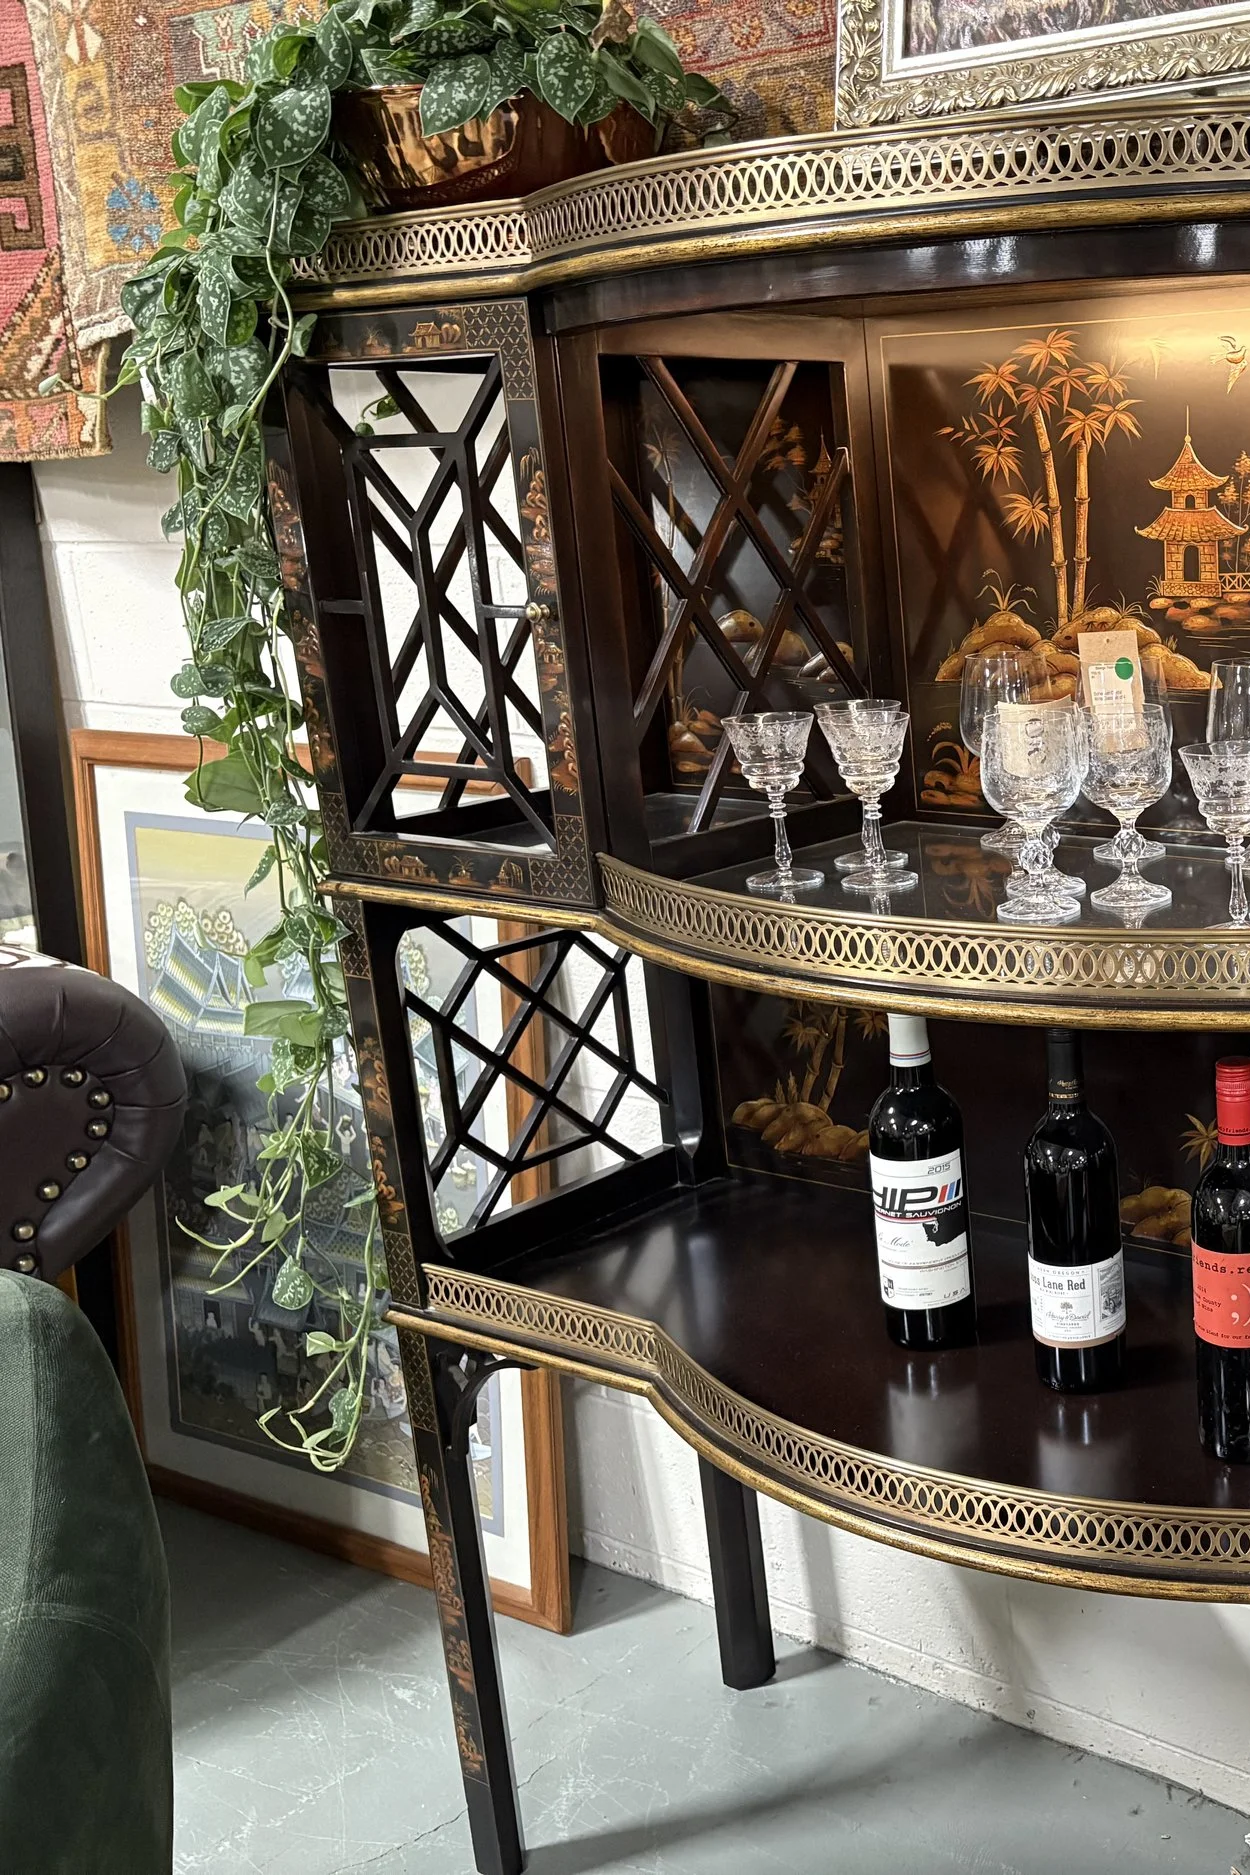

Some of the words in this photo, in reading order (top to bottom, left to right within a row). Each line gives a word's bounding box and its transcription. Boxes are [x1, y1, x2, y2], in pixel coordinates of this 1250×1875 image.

[927, 1161, 951, 1175] 2015
[905, 1201, 962, 1218] SAUVIGNON
[1042, 1276, 1063, 1291] Lane
[1067, 1278, 1086, 1291] Red
